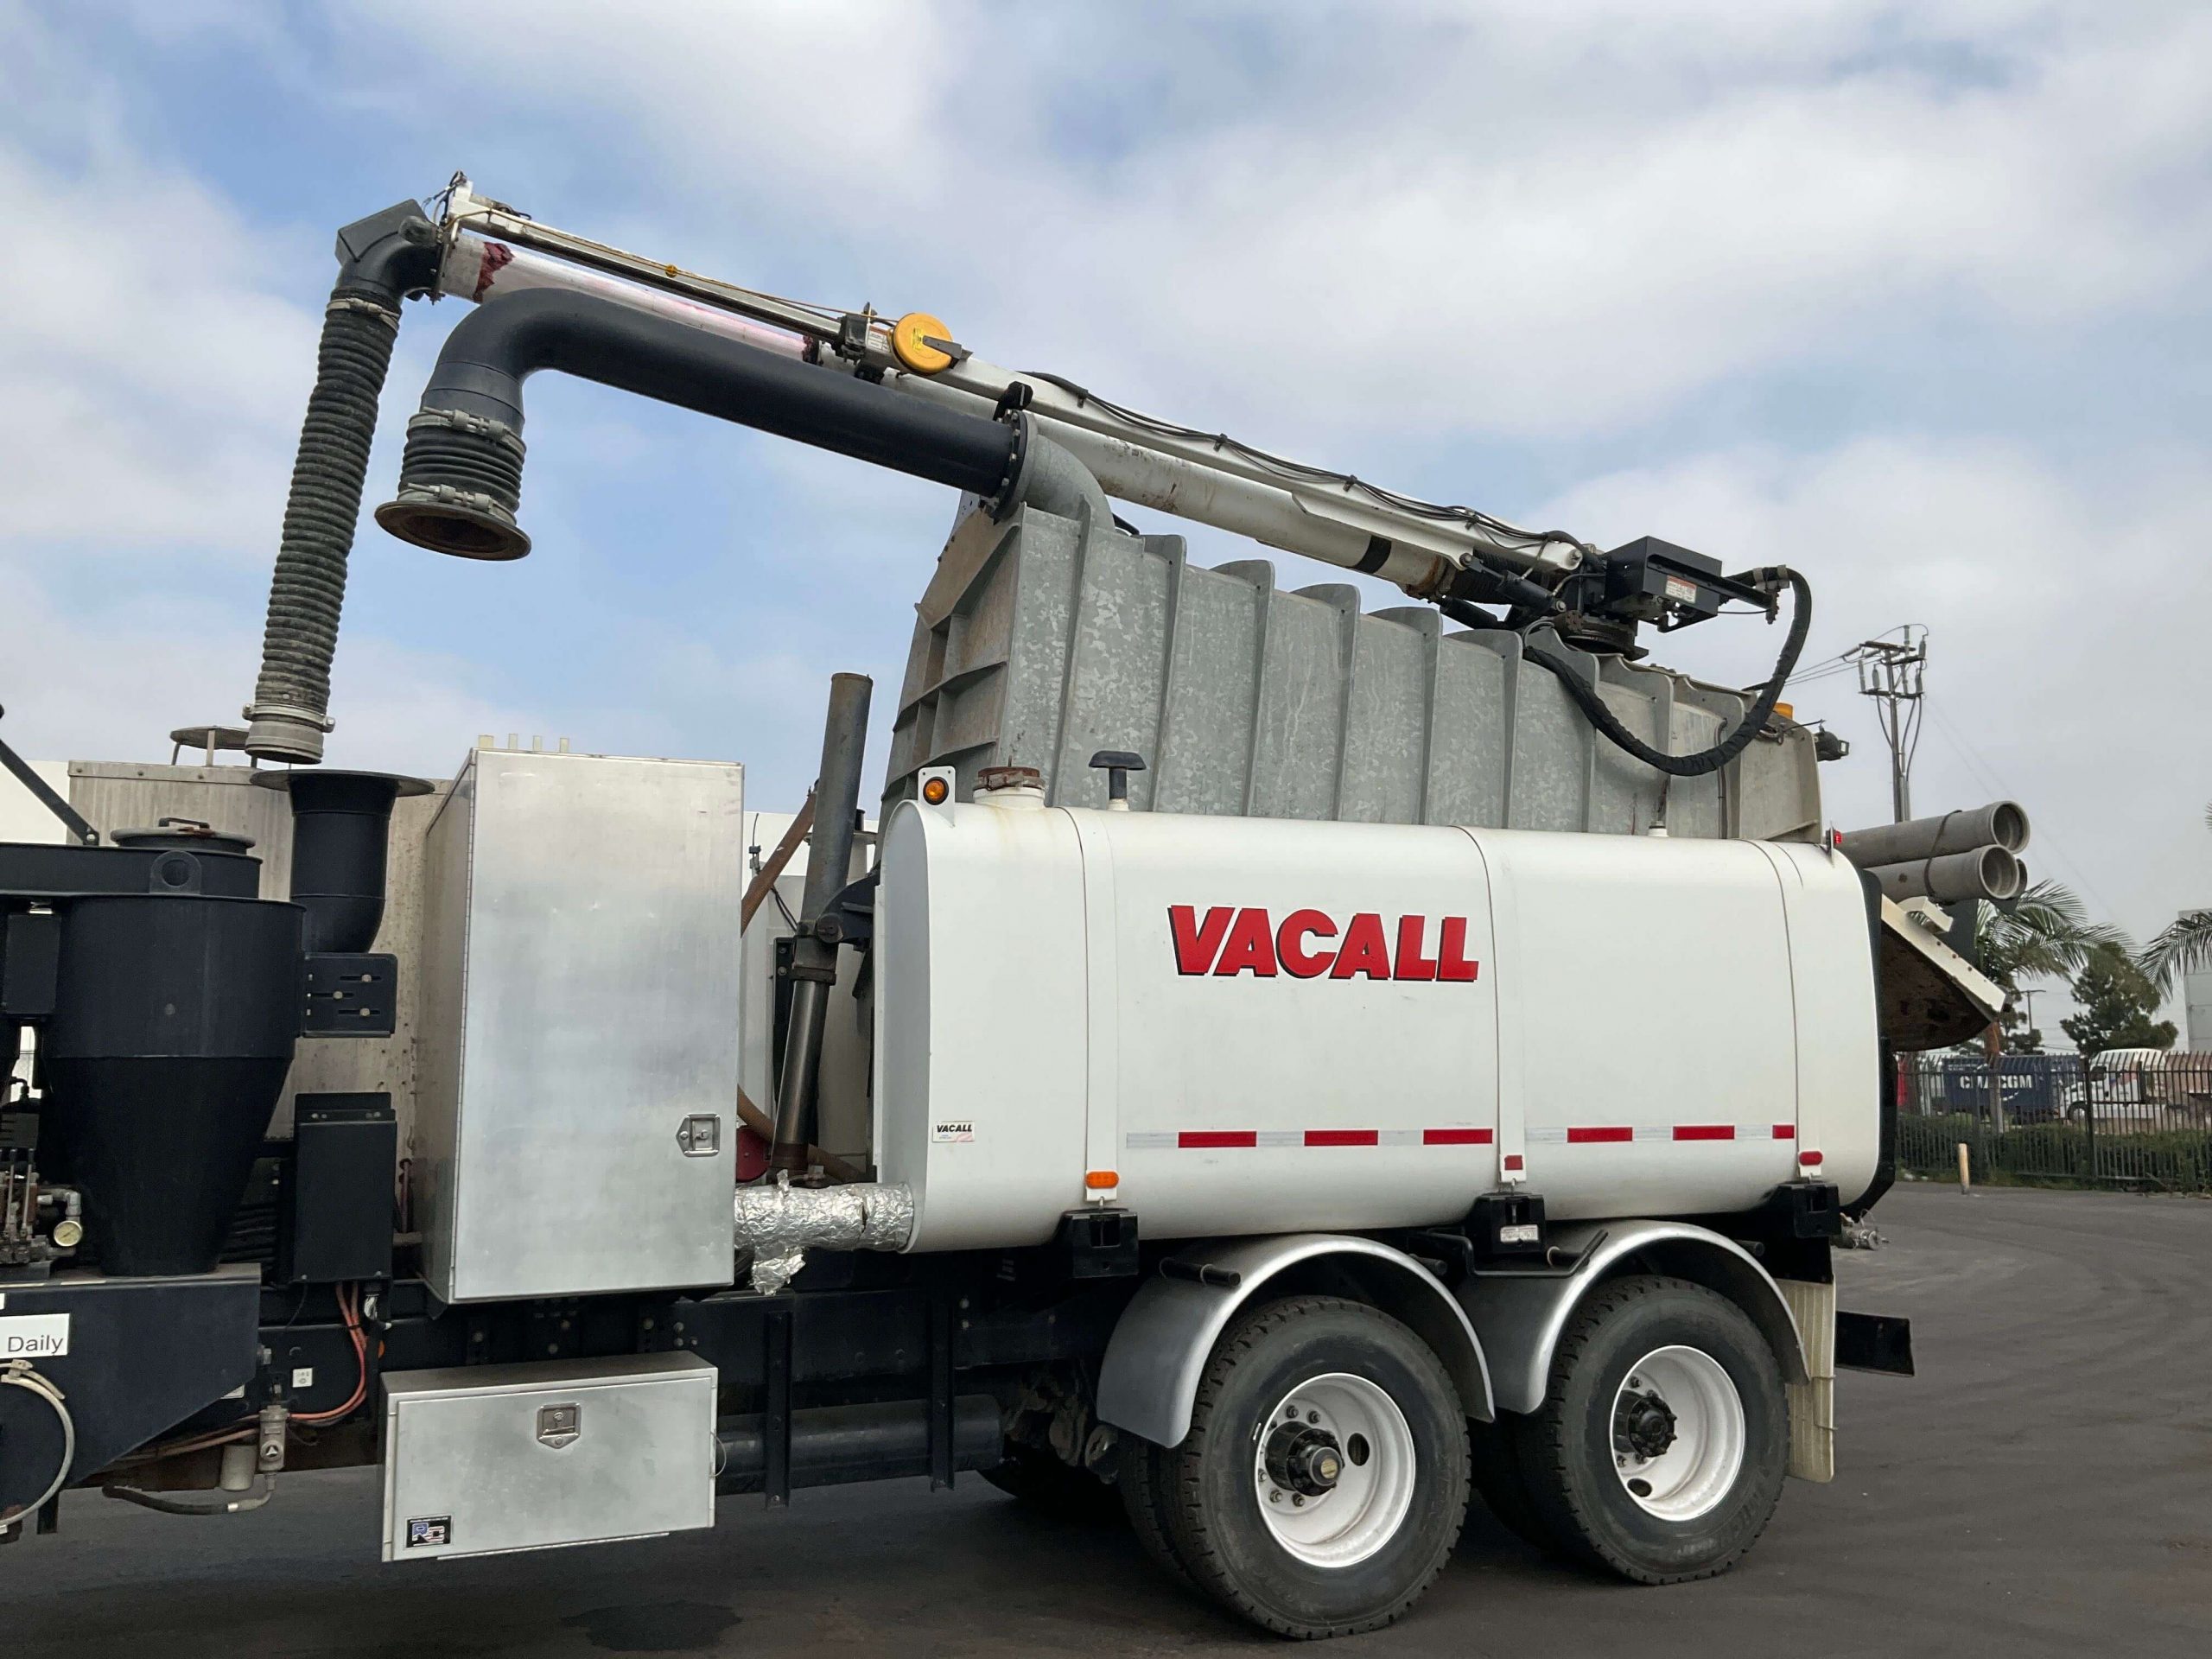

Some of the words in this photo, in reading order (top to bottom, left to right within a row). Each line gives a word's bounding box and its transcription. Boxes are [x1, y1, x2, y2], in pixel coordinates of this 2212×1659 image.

[1167, 905, 1479, 982] VACALL
[937, 1124, 972, 1133] VACALL
[8, 1335, 63, 1355] Daily
